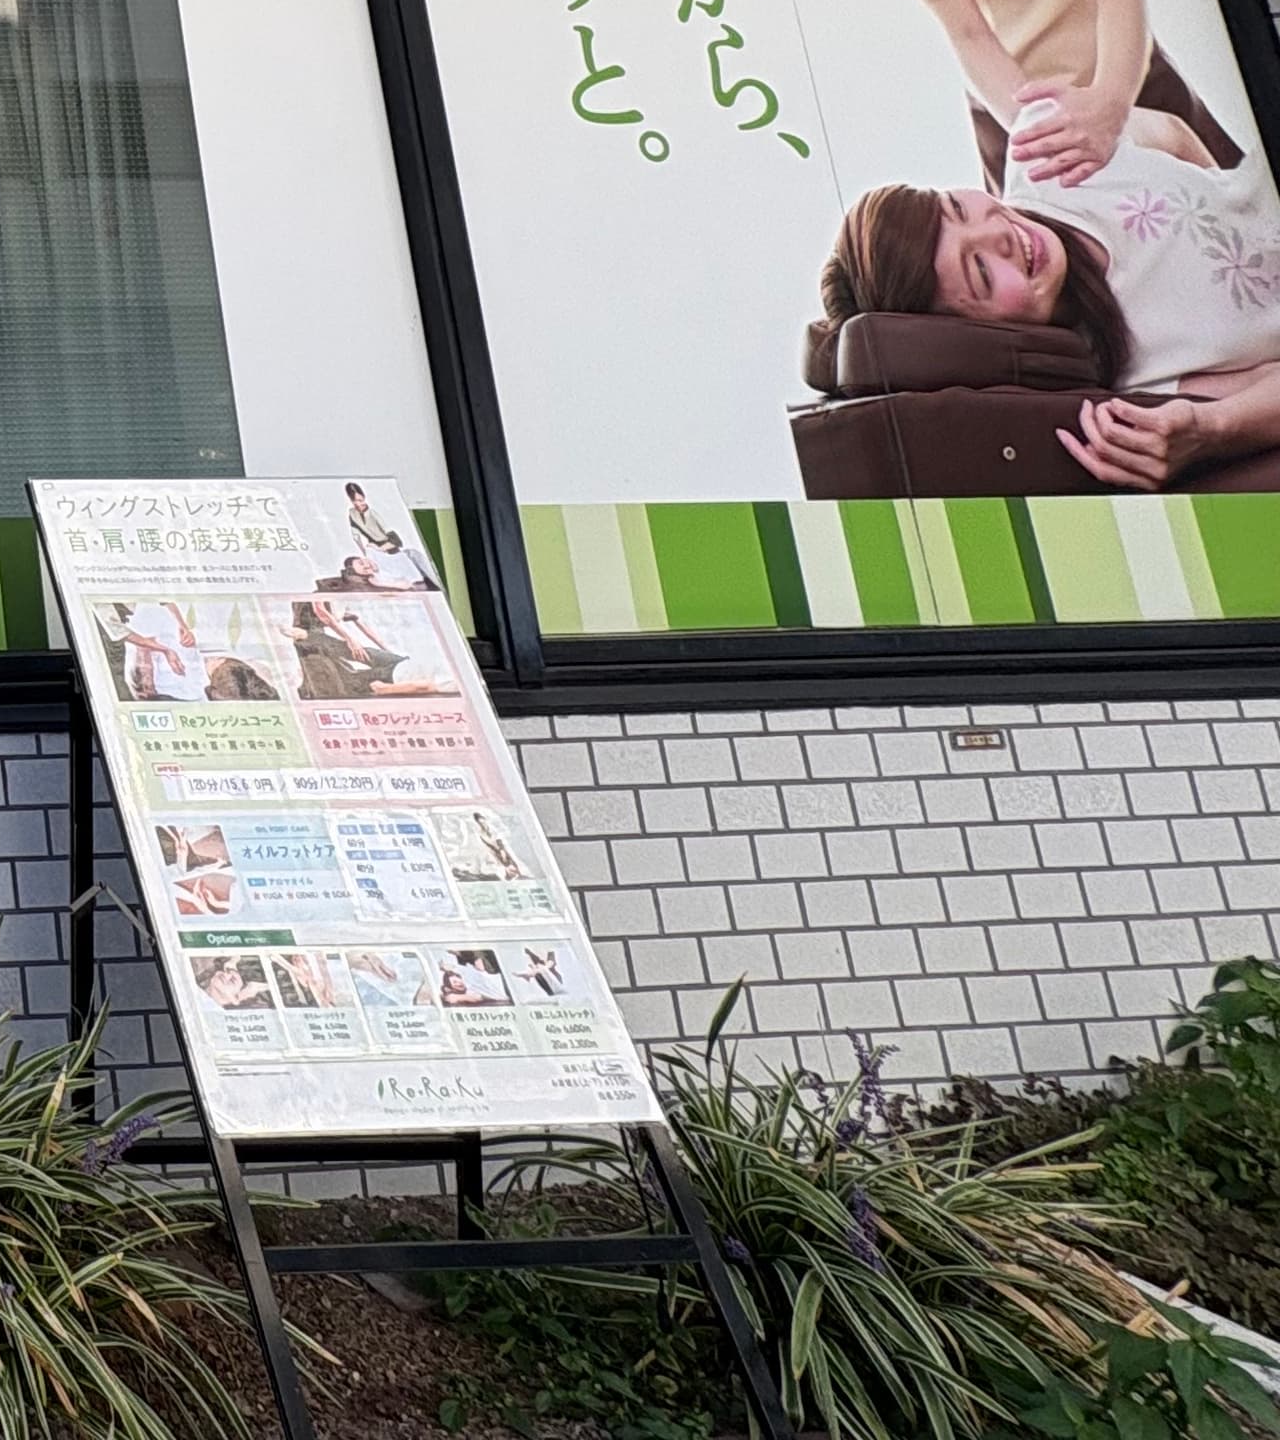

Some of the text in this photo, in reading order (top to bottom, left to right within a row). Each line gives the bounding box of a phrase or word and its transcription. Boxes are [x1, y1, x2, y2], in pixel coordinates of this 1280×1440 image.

[242, 844, 335, 858] オイルフットケア
[206, 933, 240, 946] Option
